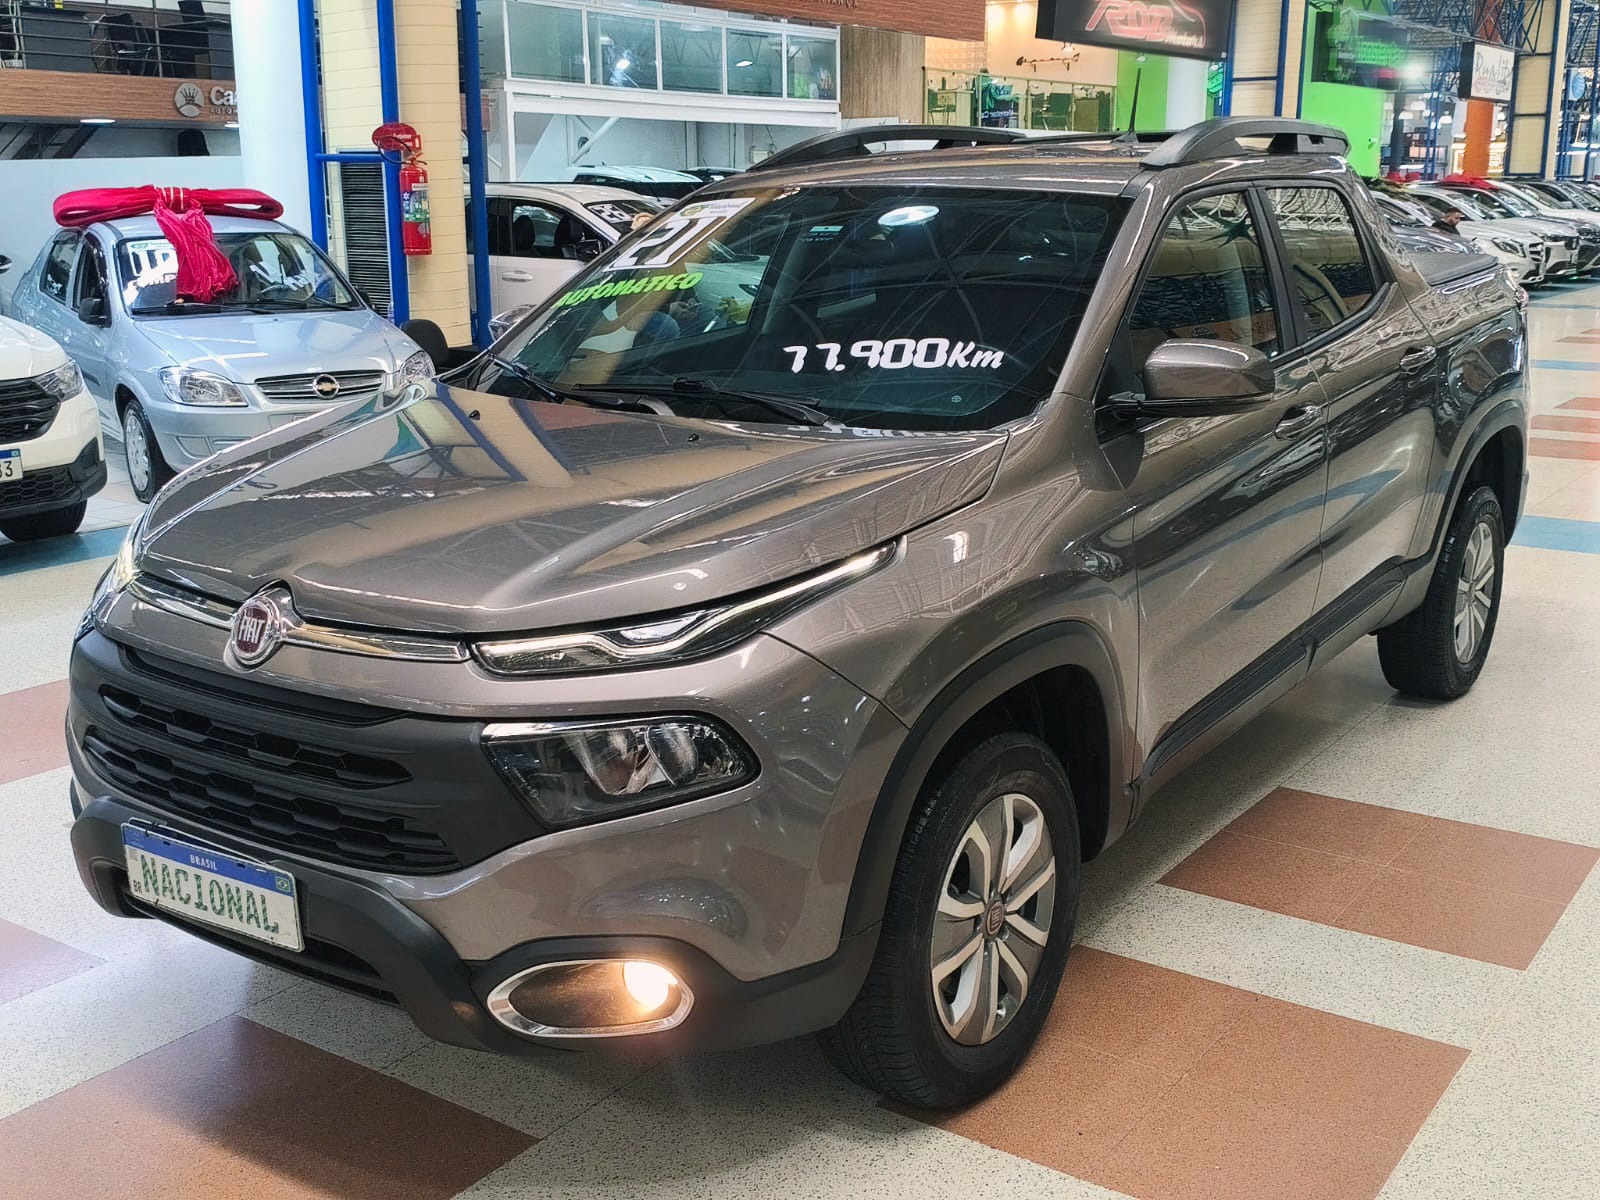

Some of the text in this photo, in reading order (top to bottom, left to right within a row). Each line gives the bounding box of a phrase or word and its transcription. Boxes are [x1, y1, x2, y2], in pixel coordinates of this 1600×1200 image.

[210, 86, 237, 106] Ca
[209, 107, 237, 116] AUTO
[613, 208, 719, 267] 21
[551, 272, 703, 309] AUTOMATICO
[0, 460, 13, 478] 3
[238, 614, 266, 644] FIAT
[189, 854, 218, 871] BRASIL
[133, 879, 143, 895] BR
[140, 854, 280, 935] NACIONAL
